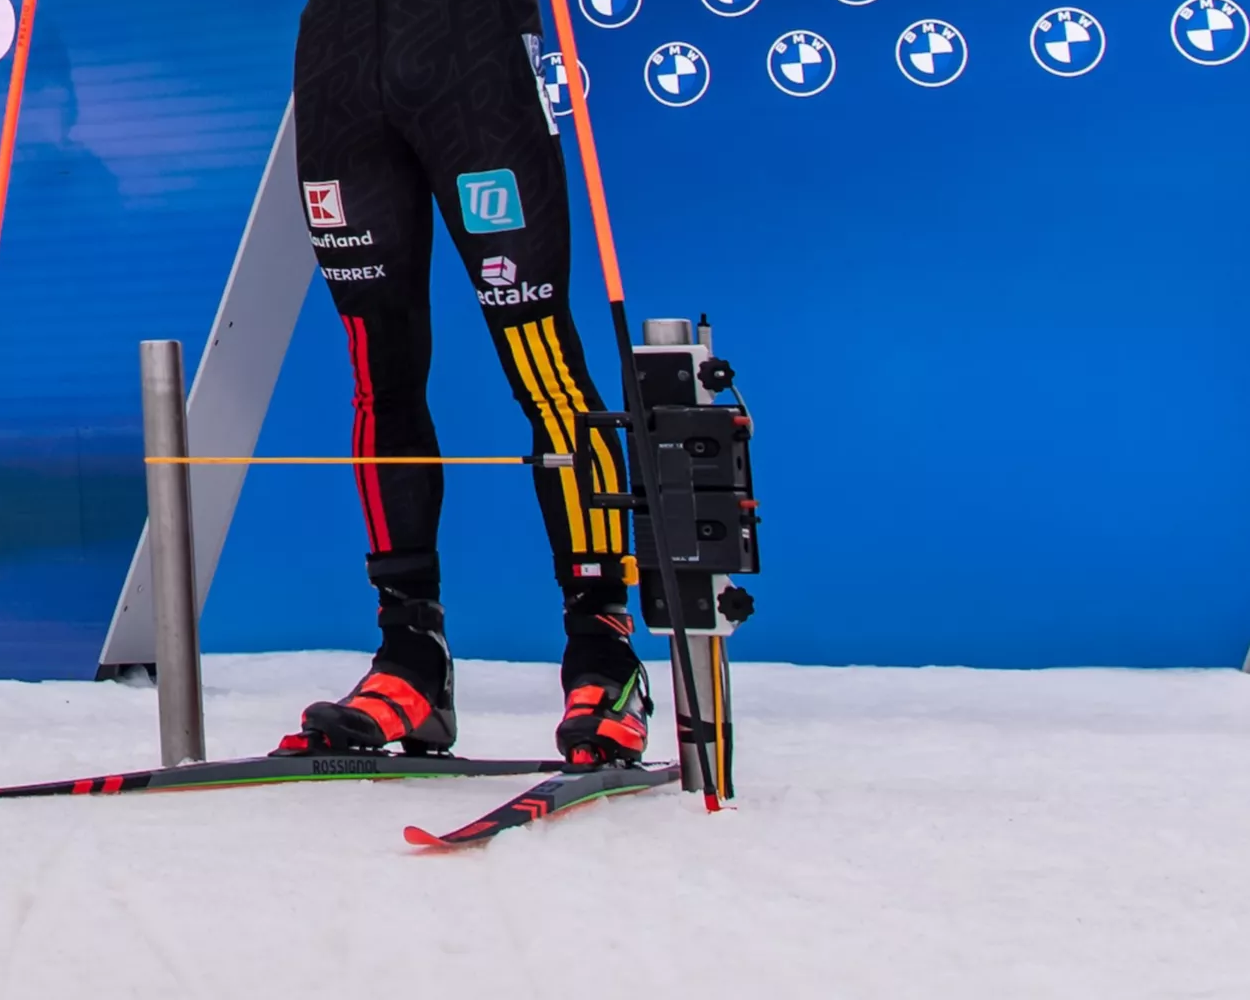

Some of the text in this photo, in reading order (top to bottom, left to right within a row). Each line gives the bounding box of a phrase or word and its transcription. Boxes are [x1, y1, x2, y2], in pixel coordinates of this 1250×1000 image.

[1038, 10, 1093, 33] BMW
[775, 33, 825, 54] BMW
[903, 22, 956, 44] BMW
[652, 45, 700, 65] BMW
[465, 180, 514, 225] TQ
[309, 230, 374, 248] aufland
[312, 759, 382, 775] ROSSIGNOL
